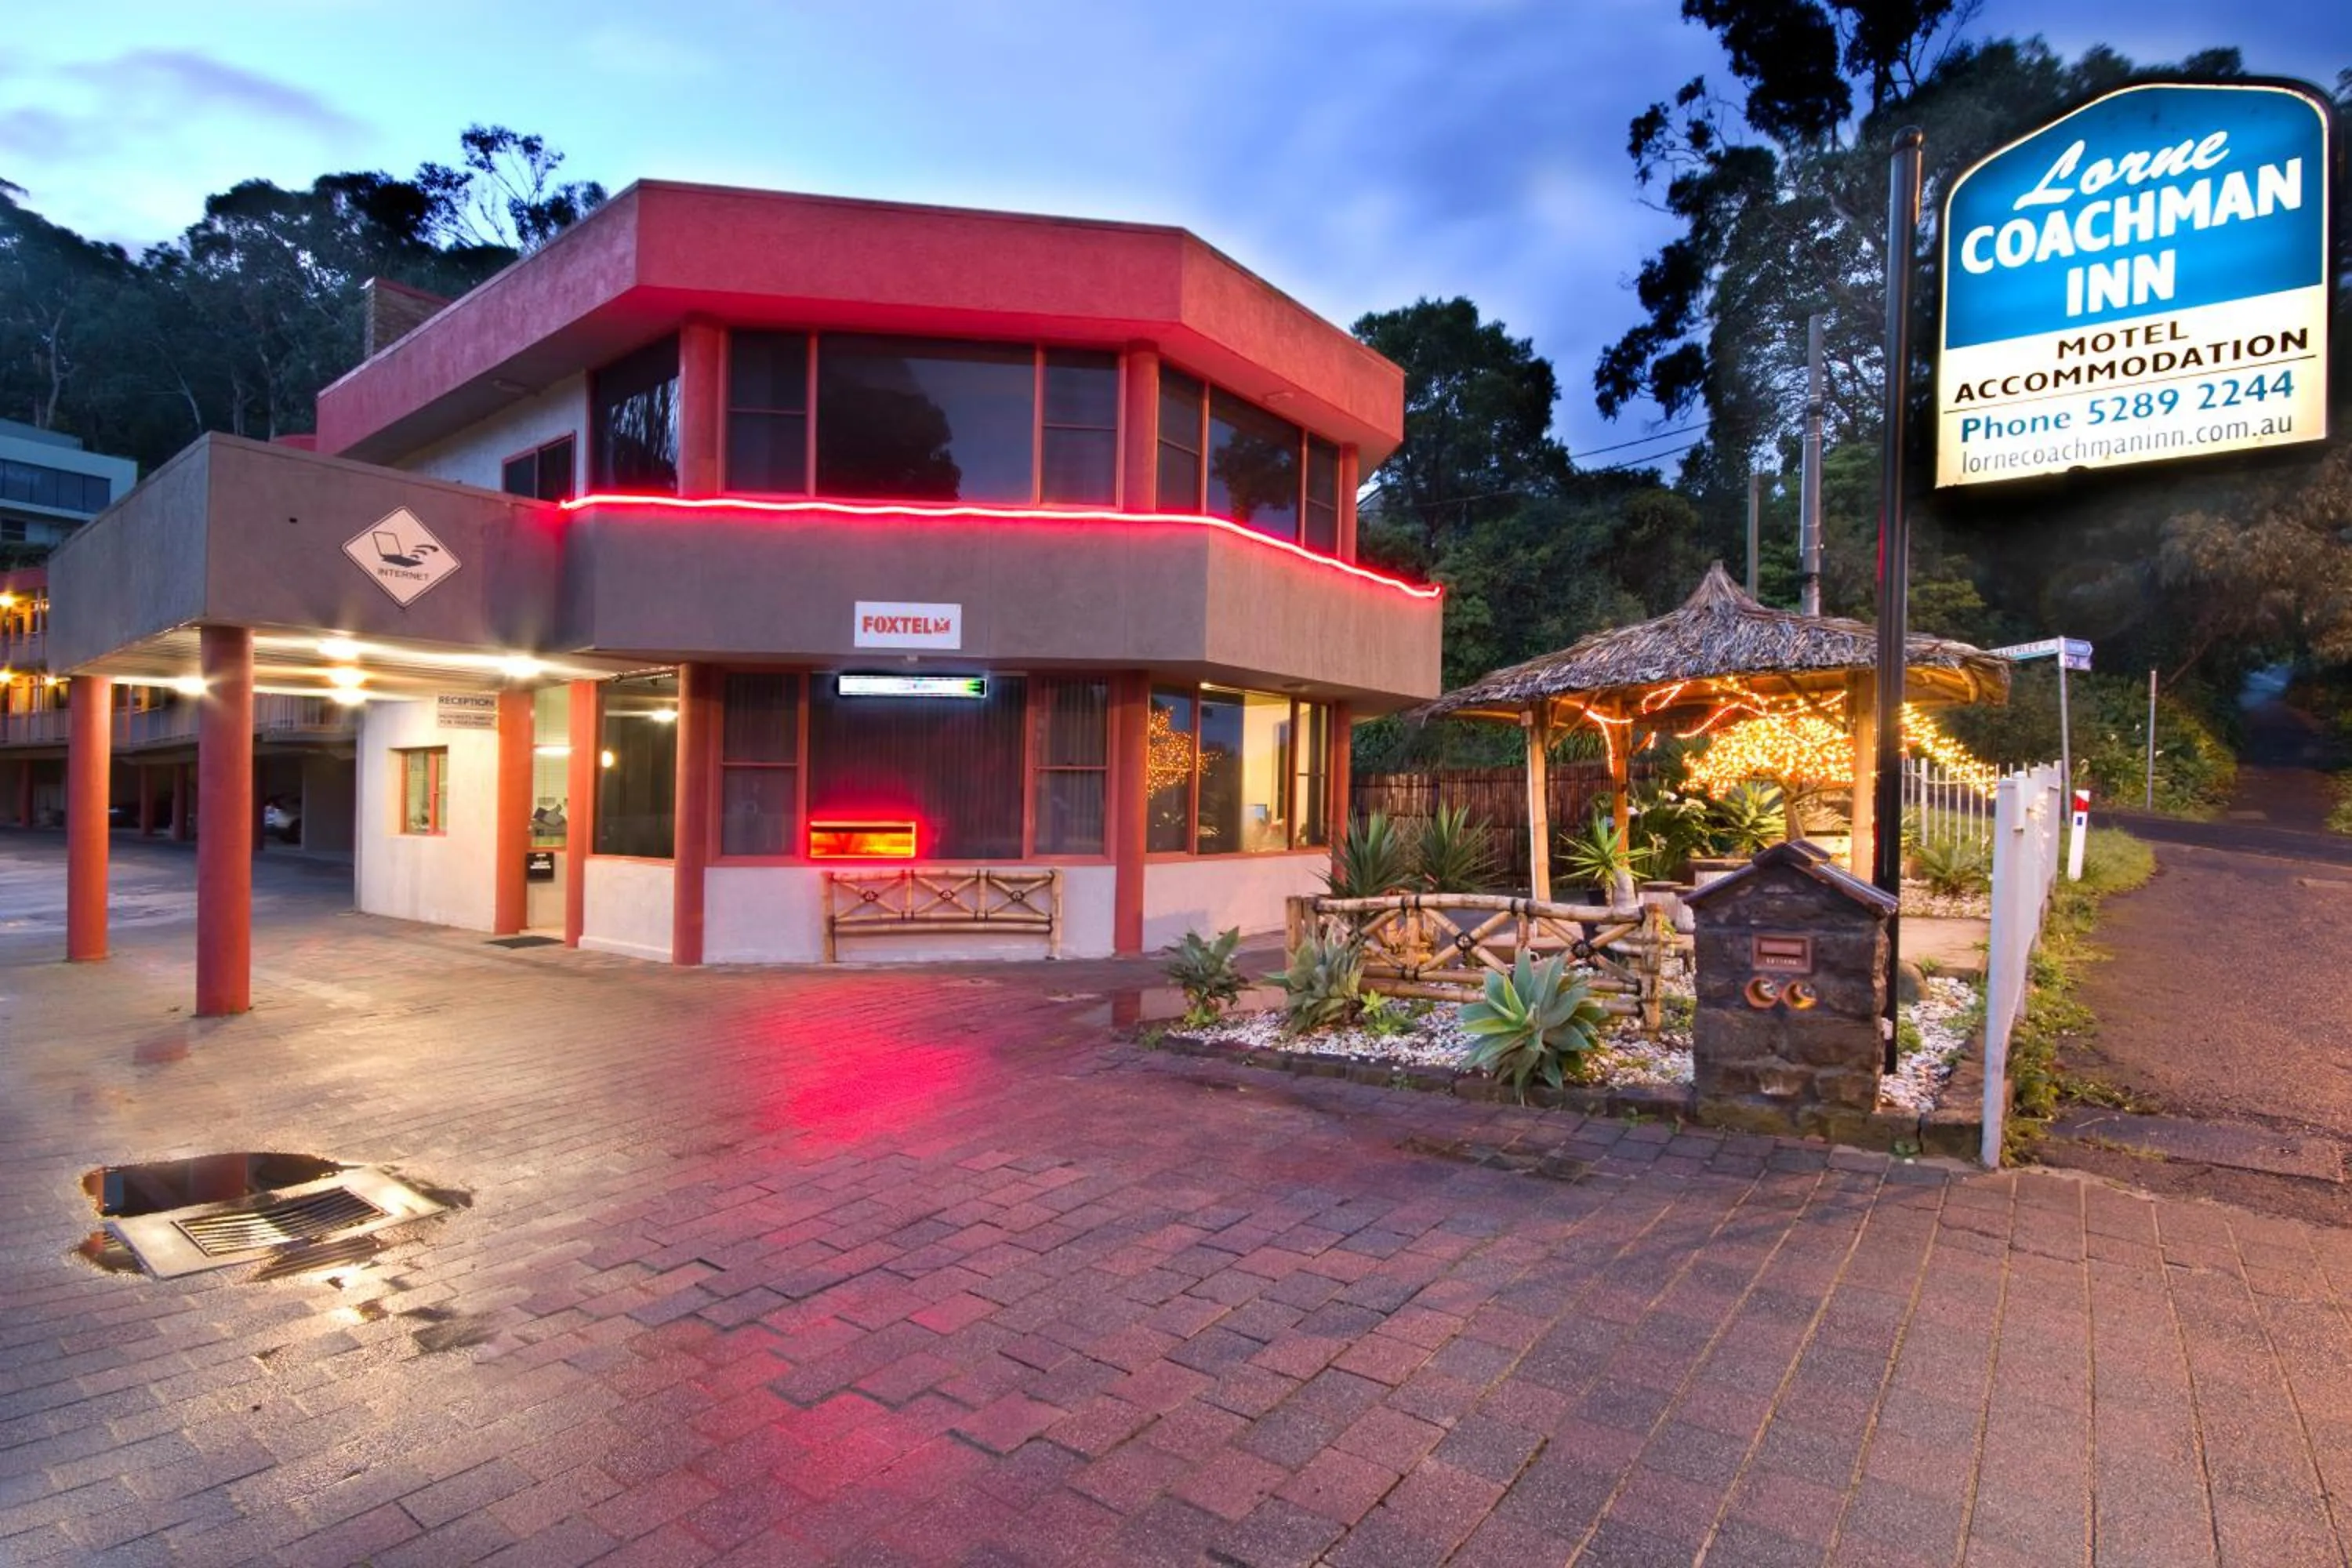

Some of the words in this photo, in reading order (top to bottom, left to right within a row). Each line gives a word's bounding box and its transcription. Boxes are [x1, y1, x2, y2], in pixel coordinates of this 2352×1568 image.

[2013, 131, 2230, 212] Lorne
[1960, 158, 2303, 274] COACHMAN
[2066, 249, 2176, 318] INN
[1954, 327, 2309, 404] ACCOMMODATION
[2057, 321, 2189, 359] MOTEL
[1961, 410, 2071, 443] Phone
[2087, 389, 2180, 425] 5289
[2197, 370, 2295, 410] 2244
[1962, 416, 2293, 474] lornecoachmaninn.com.au
[377, 568, 430, 581] INTERNET
[862, 615, 931, 634] FOXTEL
[438, 696, 495, 706] RECEPTION
